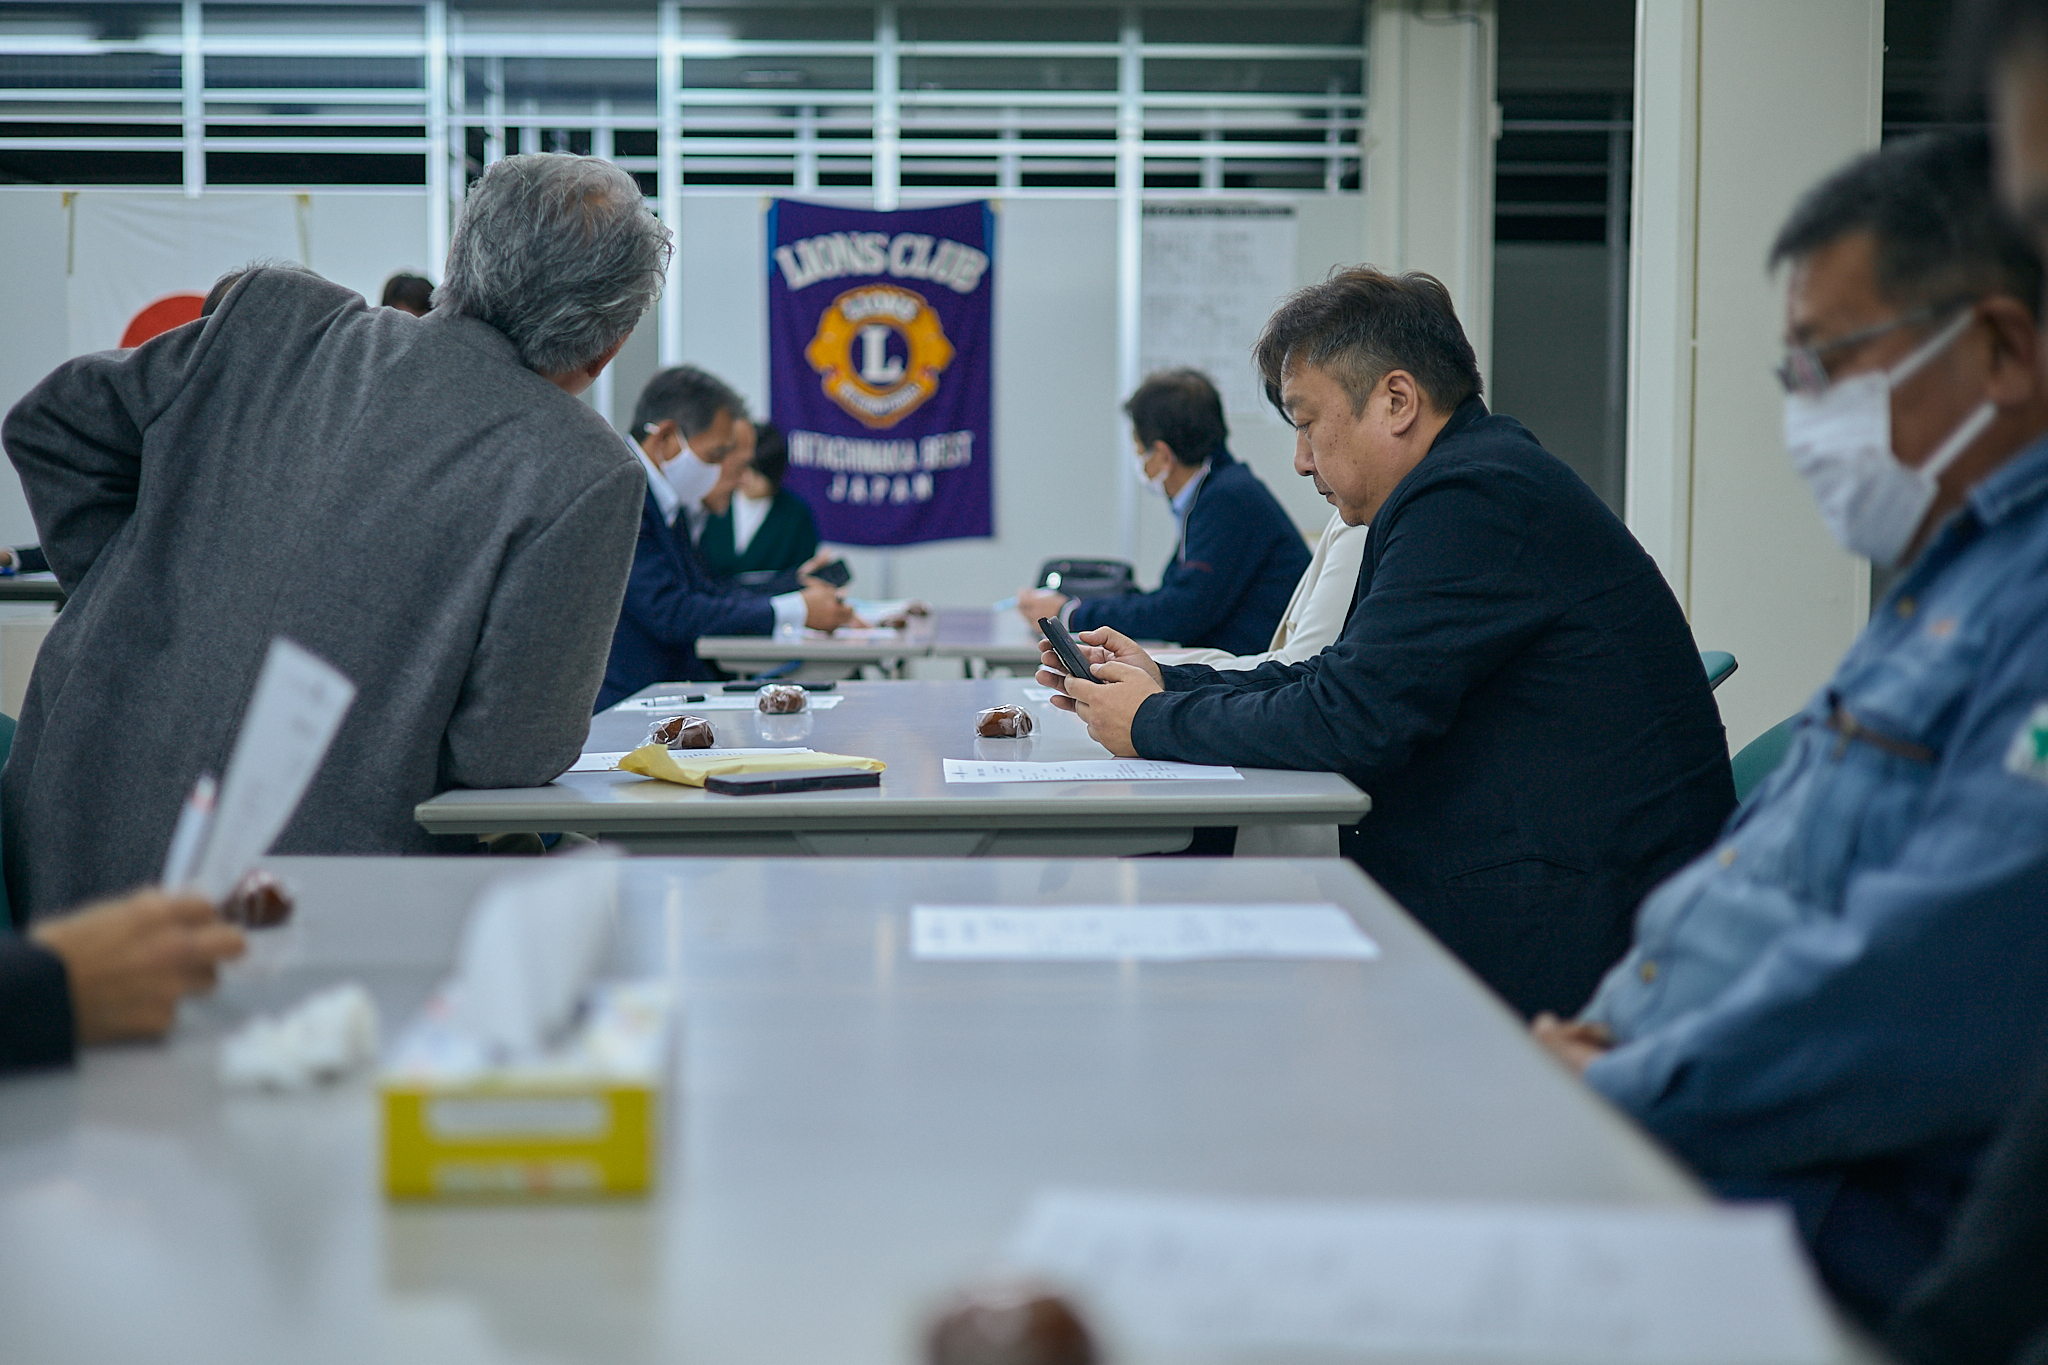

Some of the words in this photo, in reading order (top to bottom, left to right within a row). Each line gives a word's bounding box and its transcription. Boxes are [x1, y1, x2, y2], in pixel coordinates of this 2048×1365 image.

[775, 232, 889, 290] LIONS
[889, 233, 988, 293] CLUB
[861, 325, 904, 381] L
[828, 473, 933, 504] JAPAN
